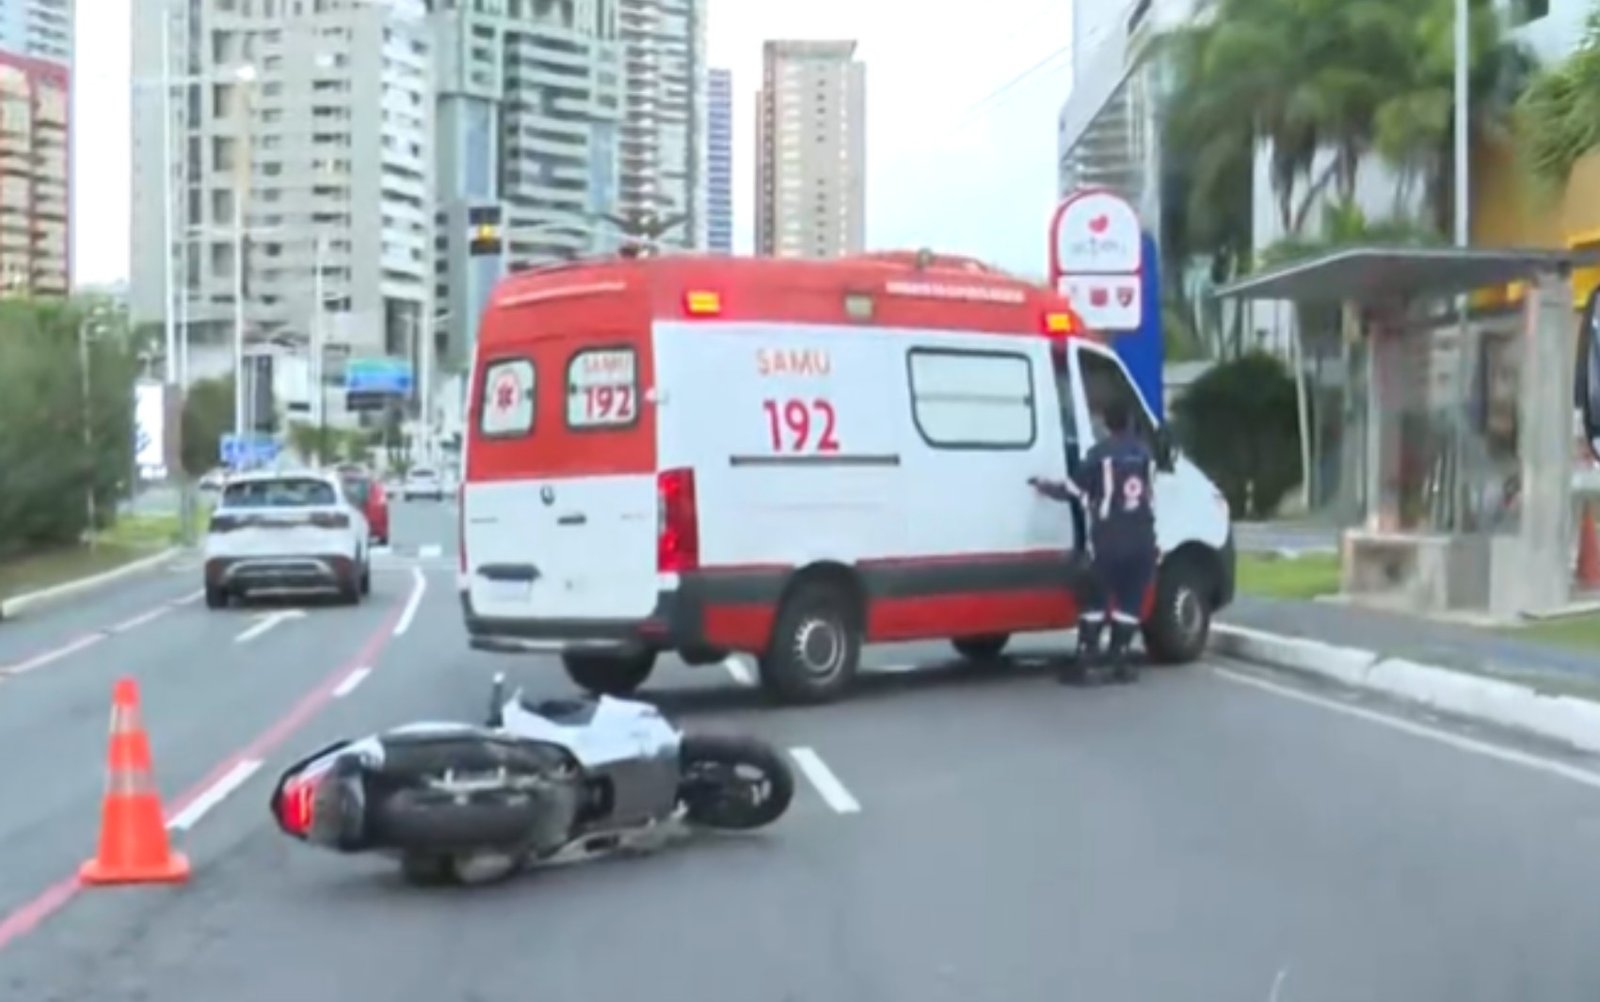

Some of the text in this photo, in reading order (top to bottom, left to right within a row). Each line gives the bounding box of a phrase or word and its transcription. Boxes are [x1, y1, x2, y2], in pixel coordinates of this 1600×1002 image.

[755, 347, 831, 376] SAMU
[583, 383, 633, 418] 192
[763, 398, 840, 452] 192
